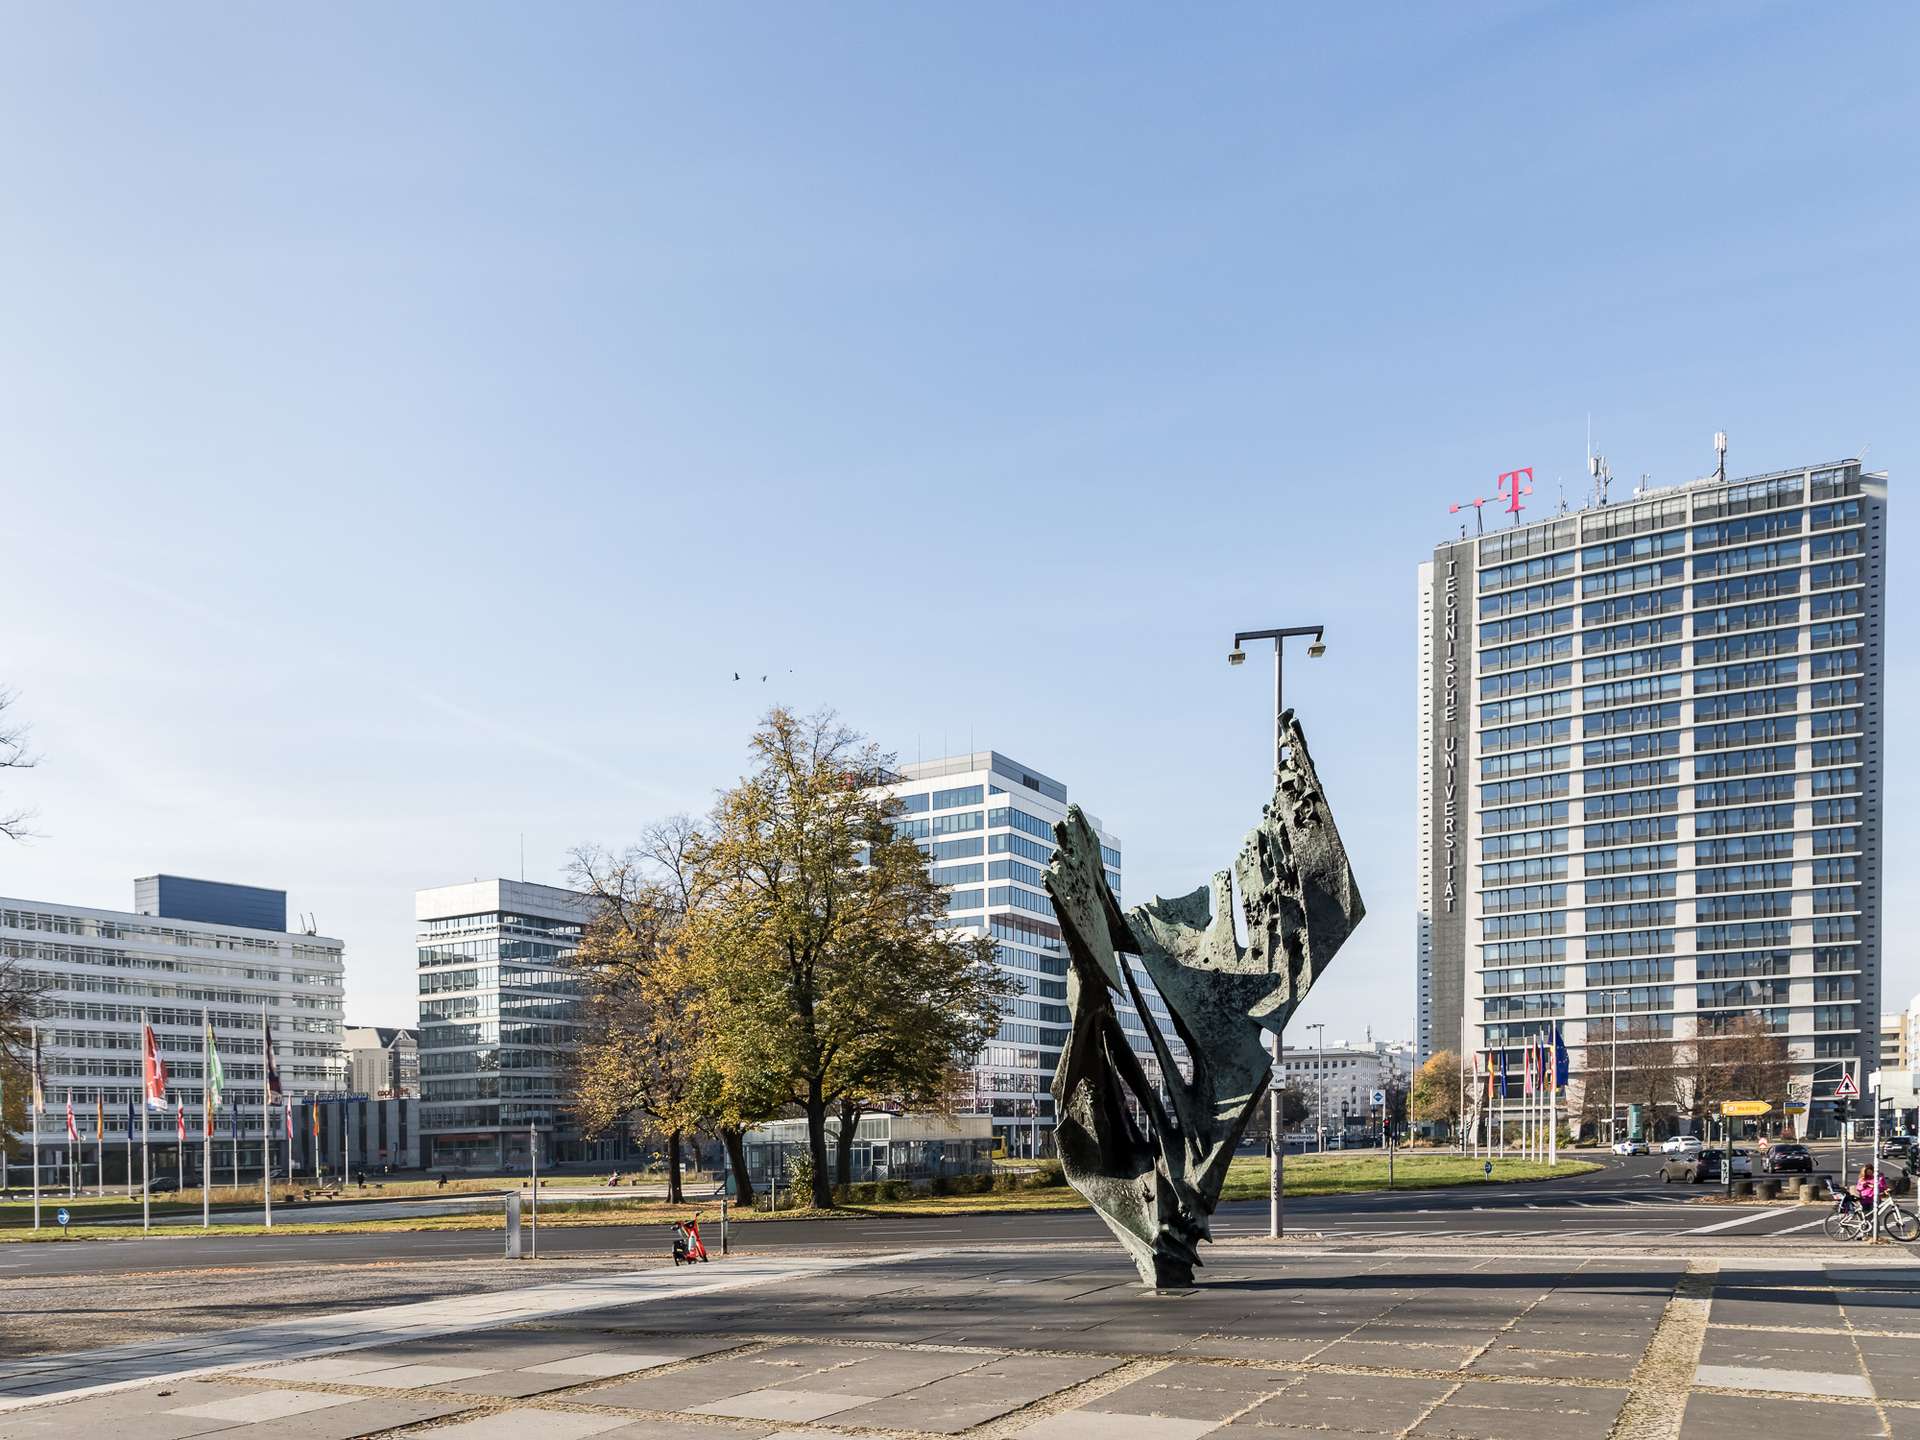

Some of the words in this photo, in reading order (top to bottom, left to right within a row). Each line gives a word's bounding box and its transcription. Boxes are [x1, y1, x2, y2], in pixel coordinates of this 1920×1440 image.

[1498, 467, 1534, 514] T
[1444, 560, 1456, 721] TECHNISCHE
[1444, 737, 1456, 912] UNIVERSITÄT
